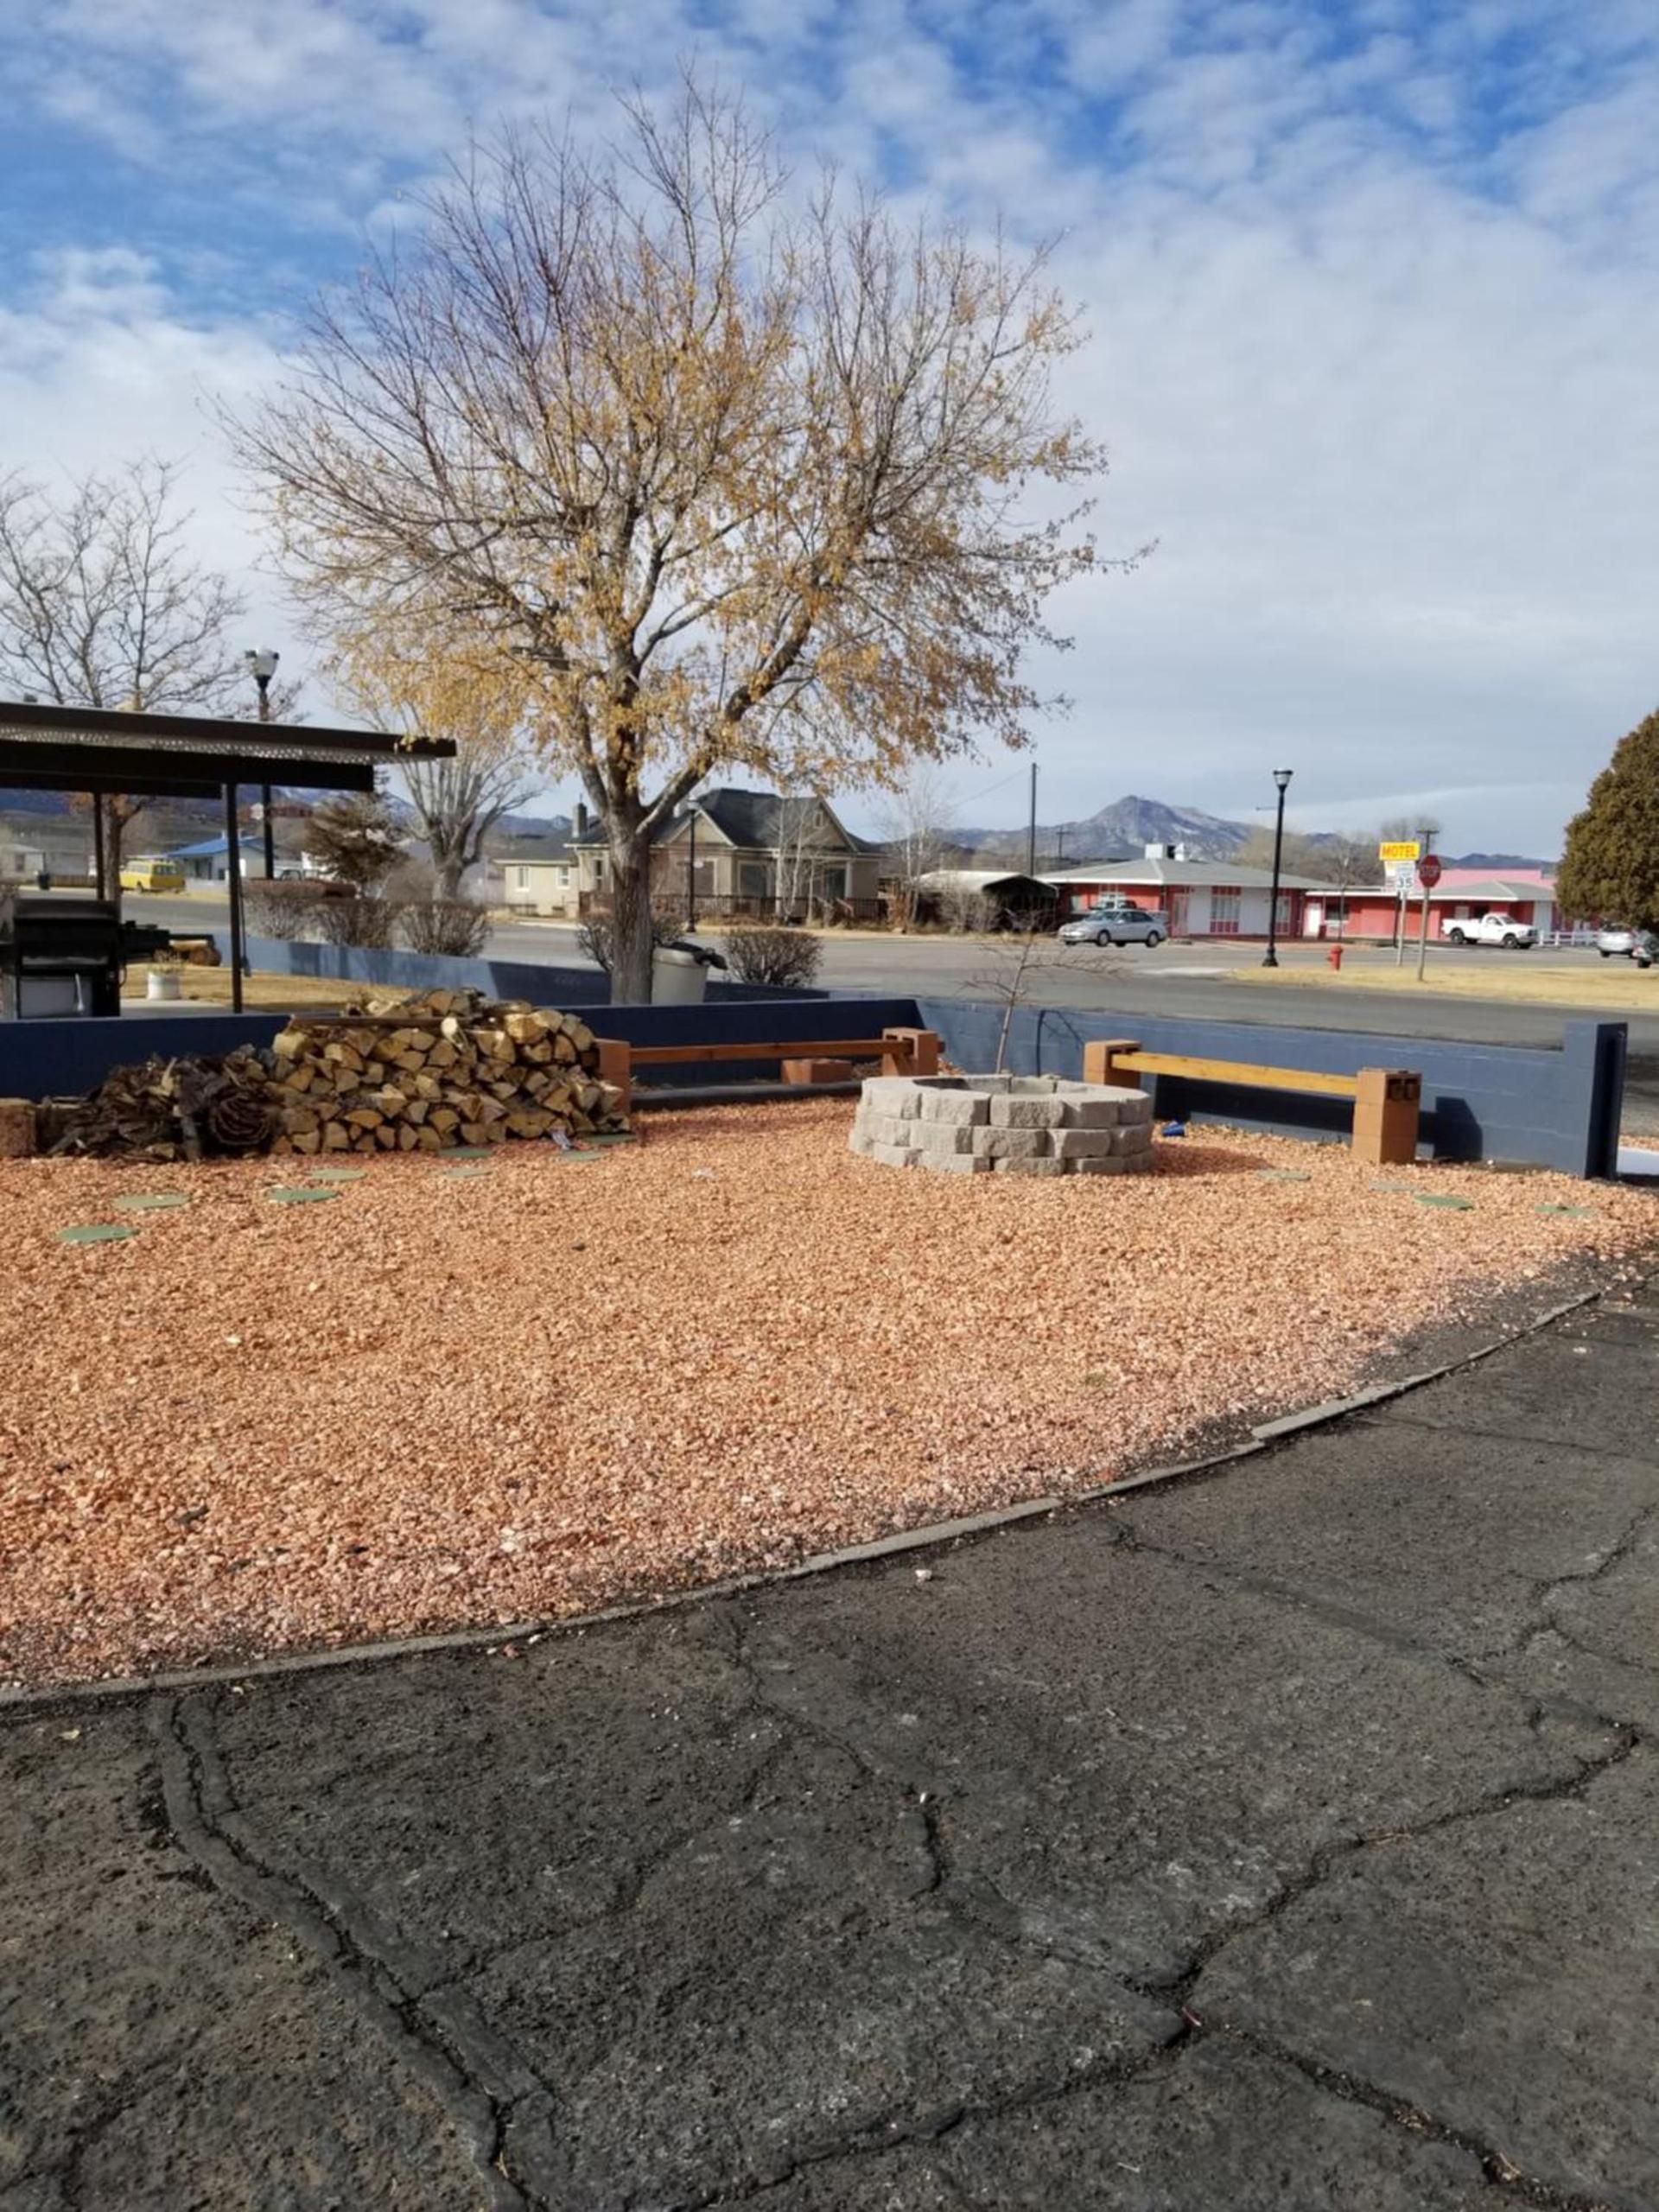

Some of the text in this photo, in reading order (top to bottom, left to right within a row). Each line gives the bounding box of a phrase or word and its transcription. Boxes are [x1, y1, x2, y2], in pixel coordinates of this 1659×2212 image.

[1382, 845, 1417, 858] MOTEL
[1420, 864, 1440, 877] STOP
[1397, 877, 1413, 888] 35
